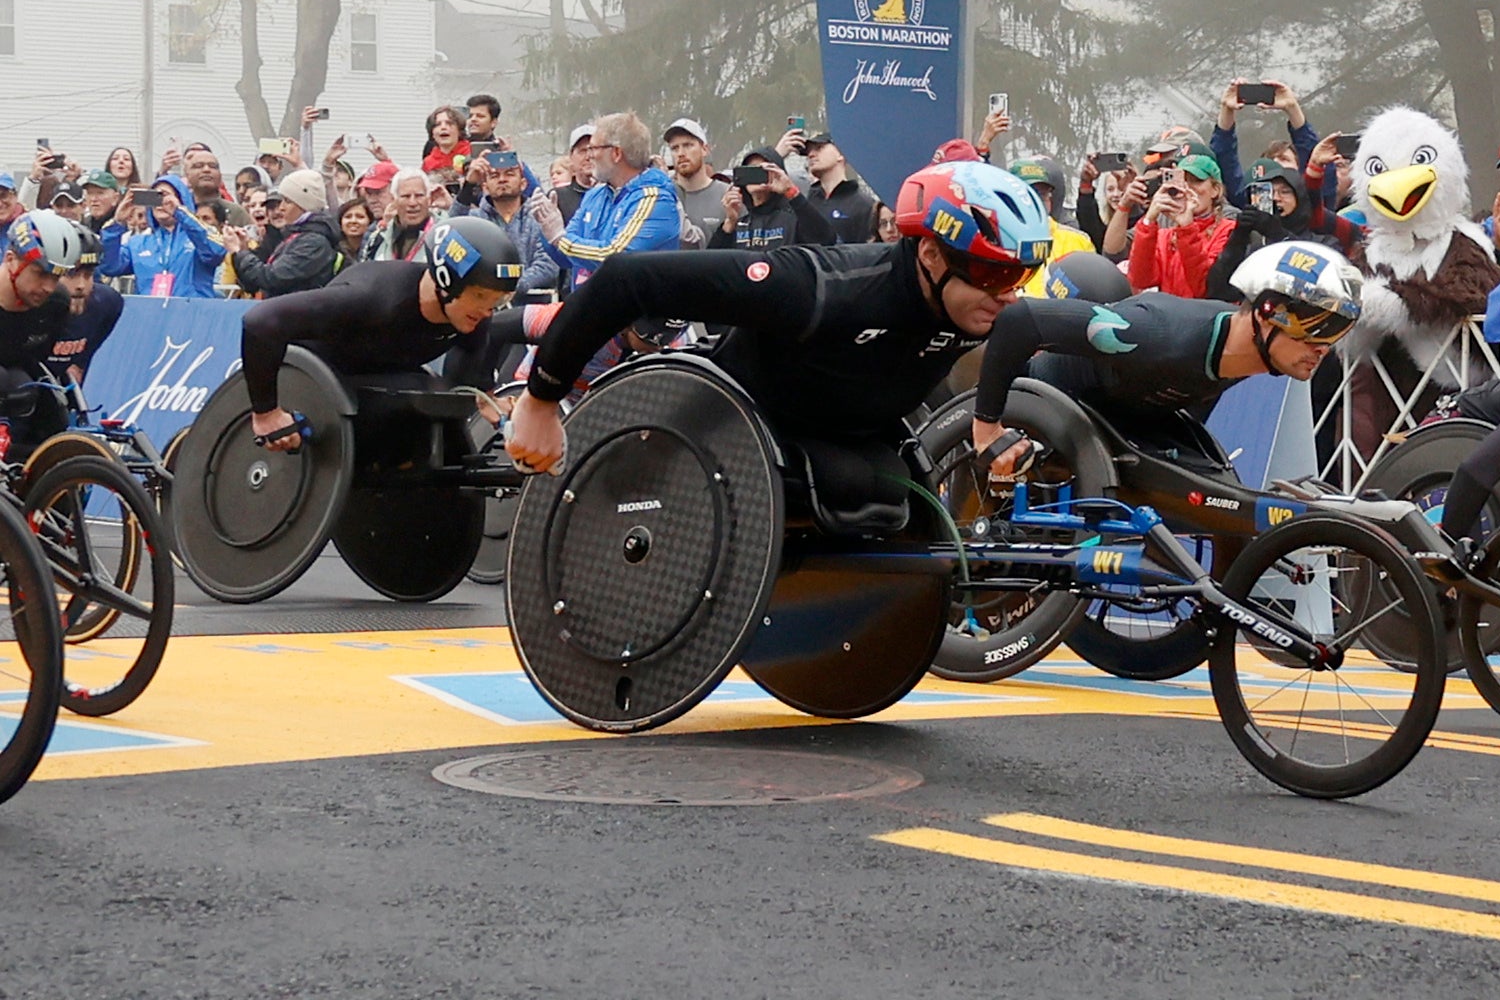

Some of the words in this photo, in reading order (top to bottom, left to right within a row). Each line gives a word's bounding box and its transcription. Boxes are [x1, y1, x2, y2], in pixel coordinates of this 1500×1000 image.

[828, 25, 879, 41] BOSTON
[881, 28, 950, 46] MARATHON
[843, 58, 881, 104] John
[879, 59, 937, 101] Hancock
[932, 209, 963, 241] W1
[1288, 251, 1318, 273] W2
[617, 500, 662, 513] HONDA
[1205, 496, 1240, 510] SAUBER
[1268, 506, 1293, 526] W2
[1093, 550, 1124, 575] W1
[1220, 602, 1255, 625] TOP
[1252, 621, 1294, 648] END
